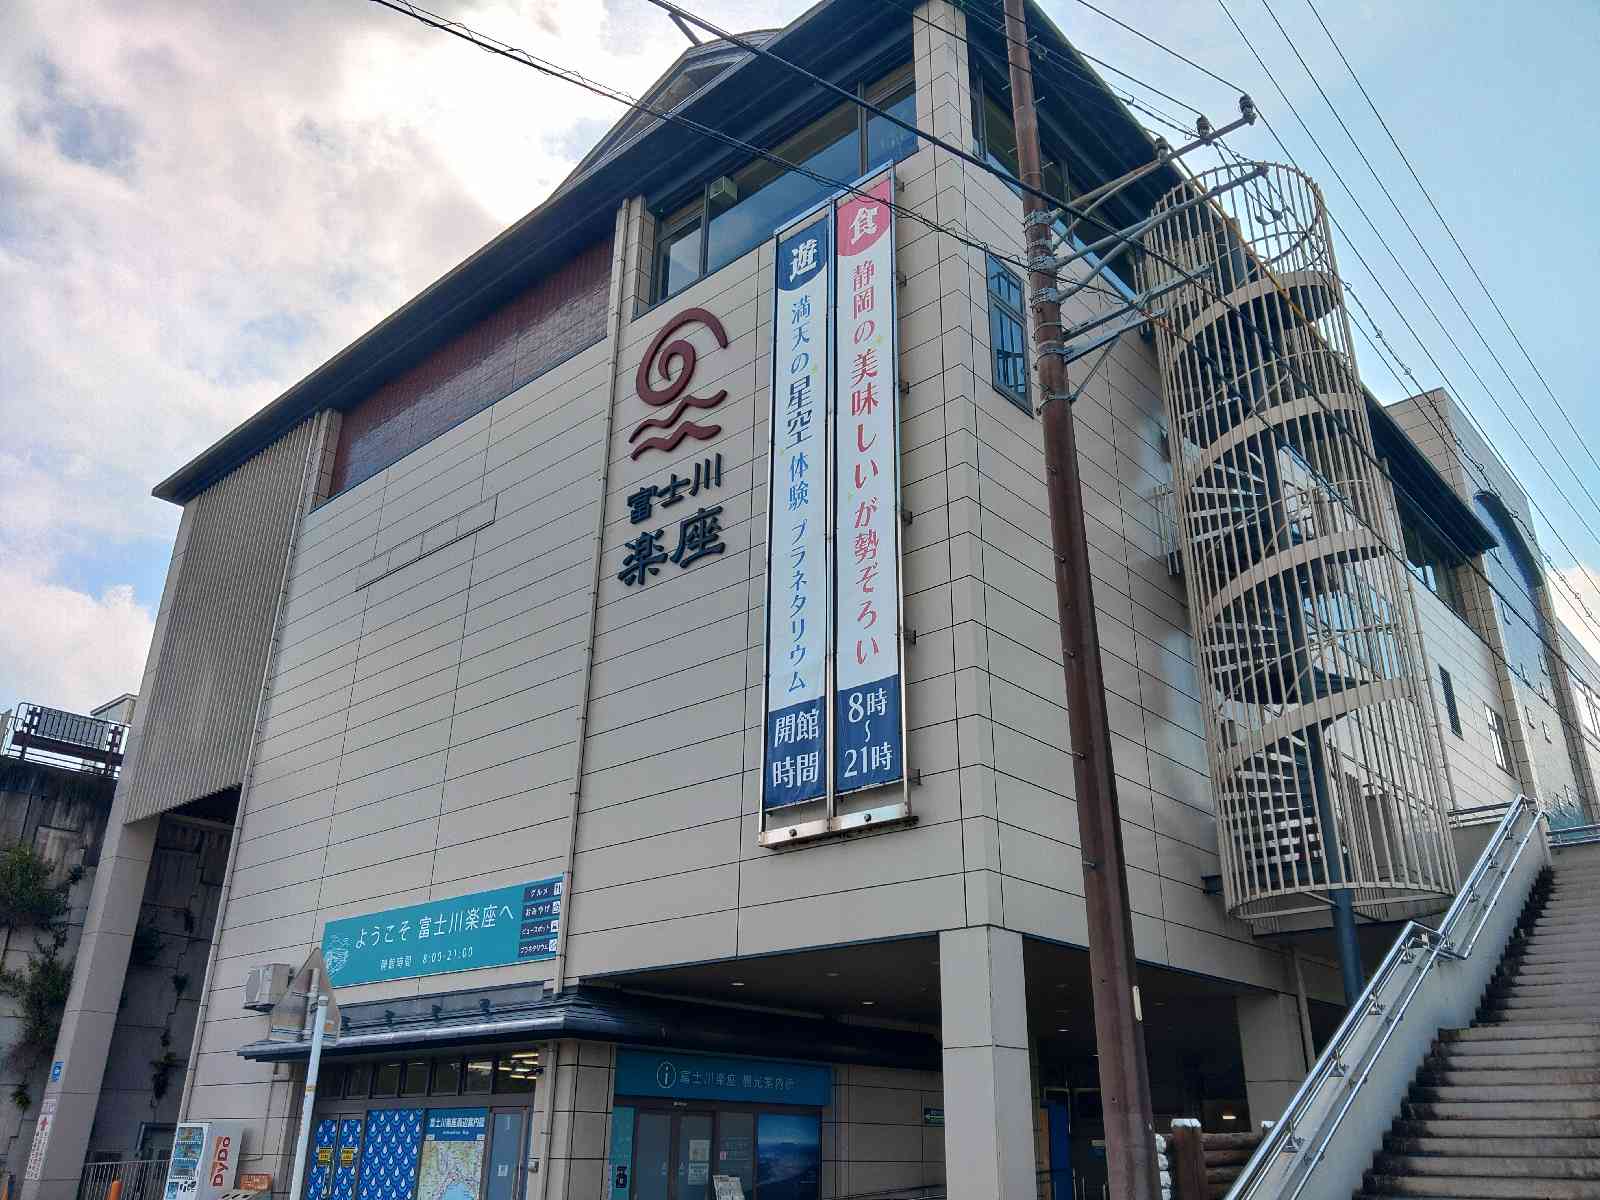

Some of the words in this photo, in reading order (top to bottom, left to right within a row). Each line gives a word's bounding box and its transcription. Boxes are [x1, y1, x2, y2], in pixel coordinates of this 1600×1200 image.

[850, 206, 880, 244] 食
[790, 238, 818, 282] 遊
[851, 259, 880, 665] 静岡の美味しいが勢ぞろい
[627, 452, 722, 524] 富士川
[617, 505, 726, 586] 楽座
[848, 688, 888, 723] 8時
[774, 709, 820, 748] 開館
[772, 751, 820, 789] 時間
[844, 741, 892, 778] 21時
[355, 920, 411, 949] ようこそ
[417, 903, 514, 939] 富士川楽座へ
